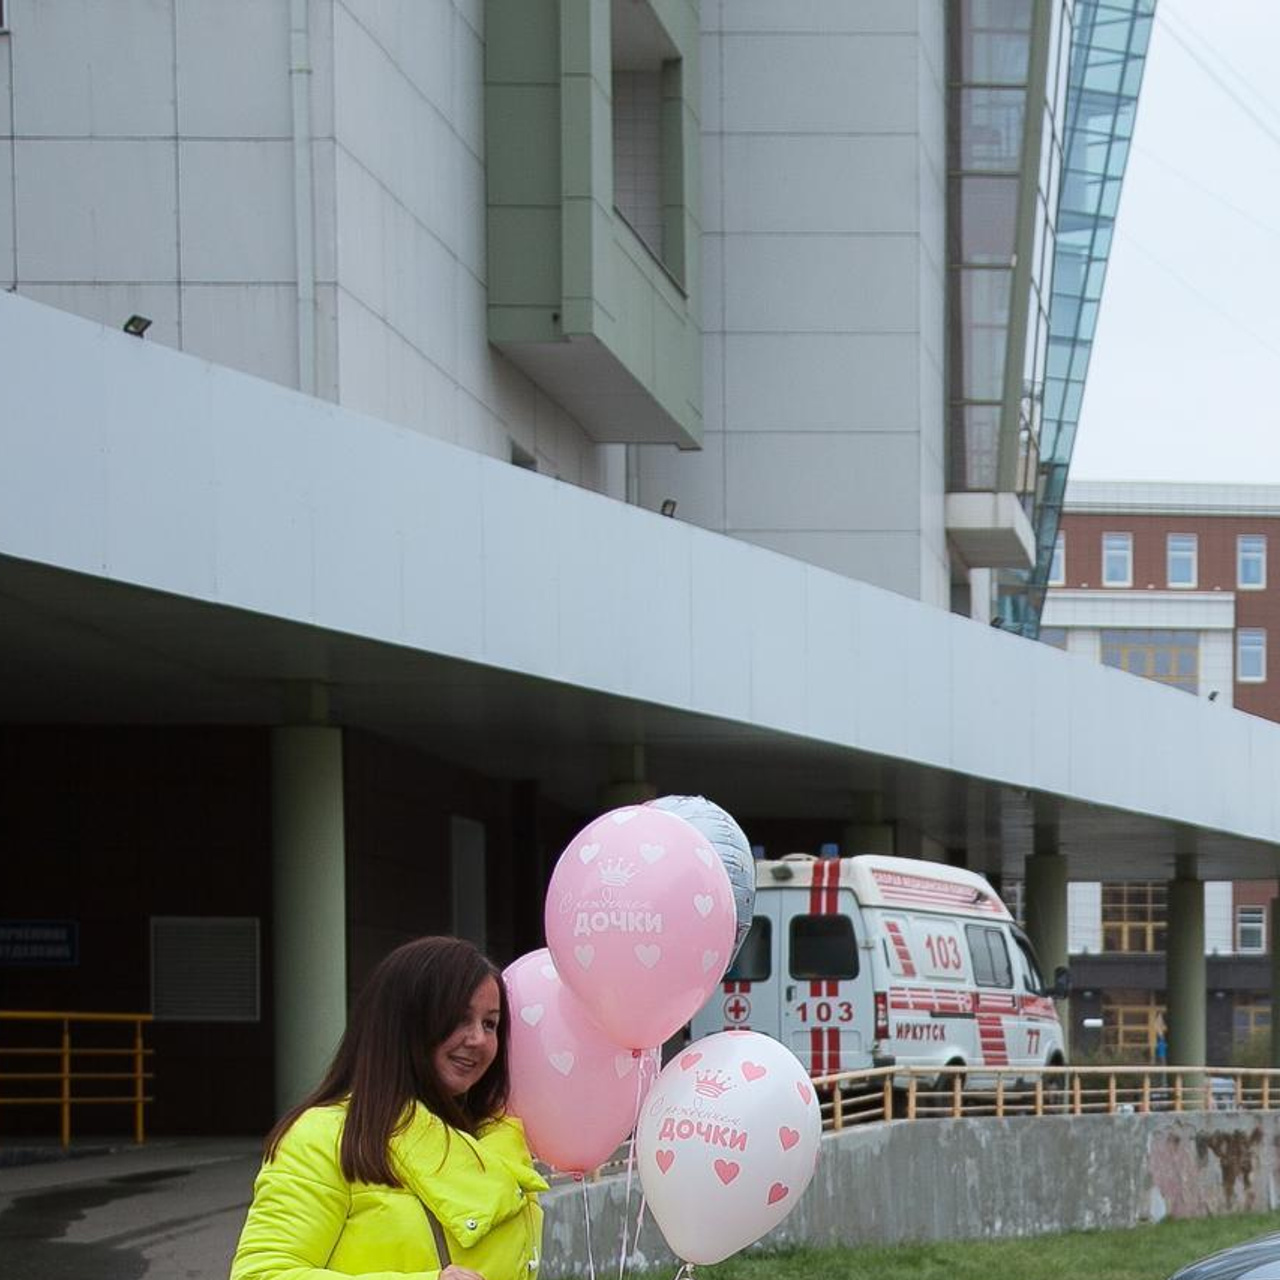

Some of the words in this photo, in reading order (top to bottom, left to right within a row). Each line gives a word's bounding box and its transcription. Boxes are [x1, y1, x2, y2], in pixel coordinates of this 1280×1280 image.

[574, 911, 662, 936] ДОЧКИ
[925, 932, 962, 970] 103
[796, 1001, 853, 1023] 103
[896, 1021, 945, 1041] ИРКУТСК
[1027, 1029, 1040, 1054] 77
[658, 1117, 748, 1152] ДОЧКИ
